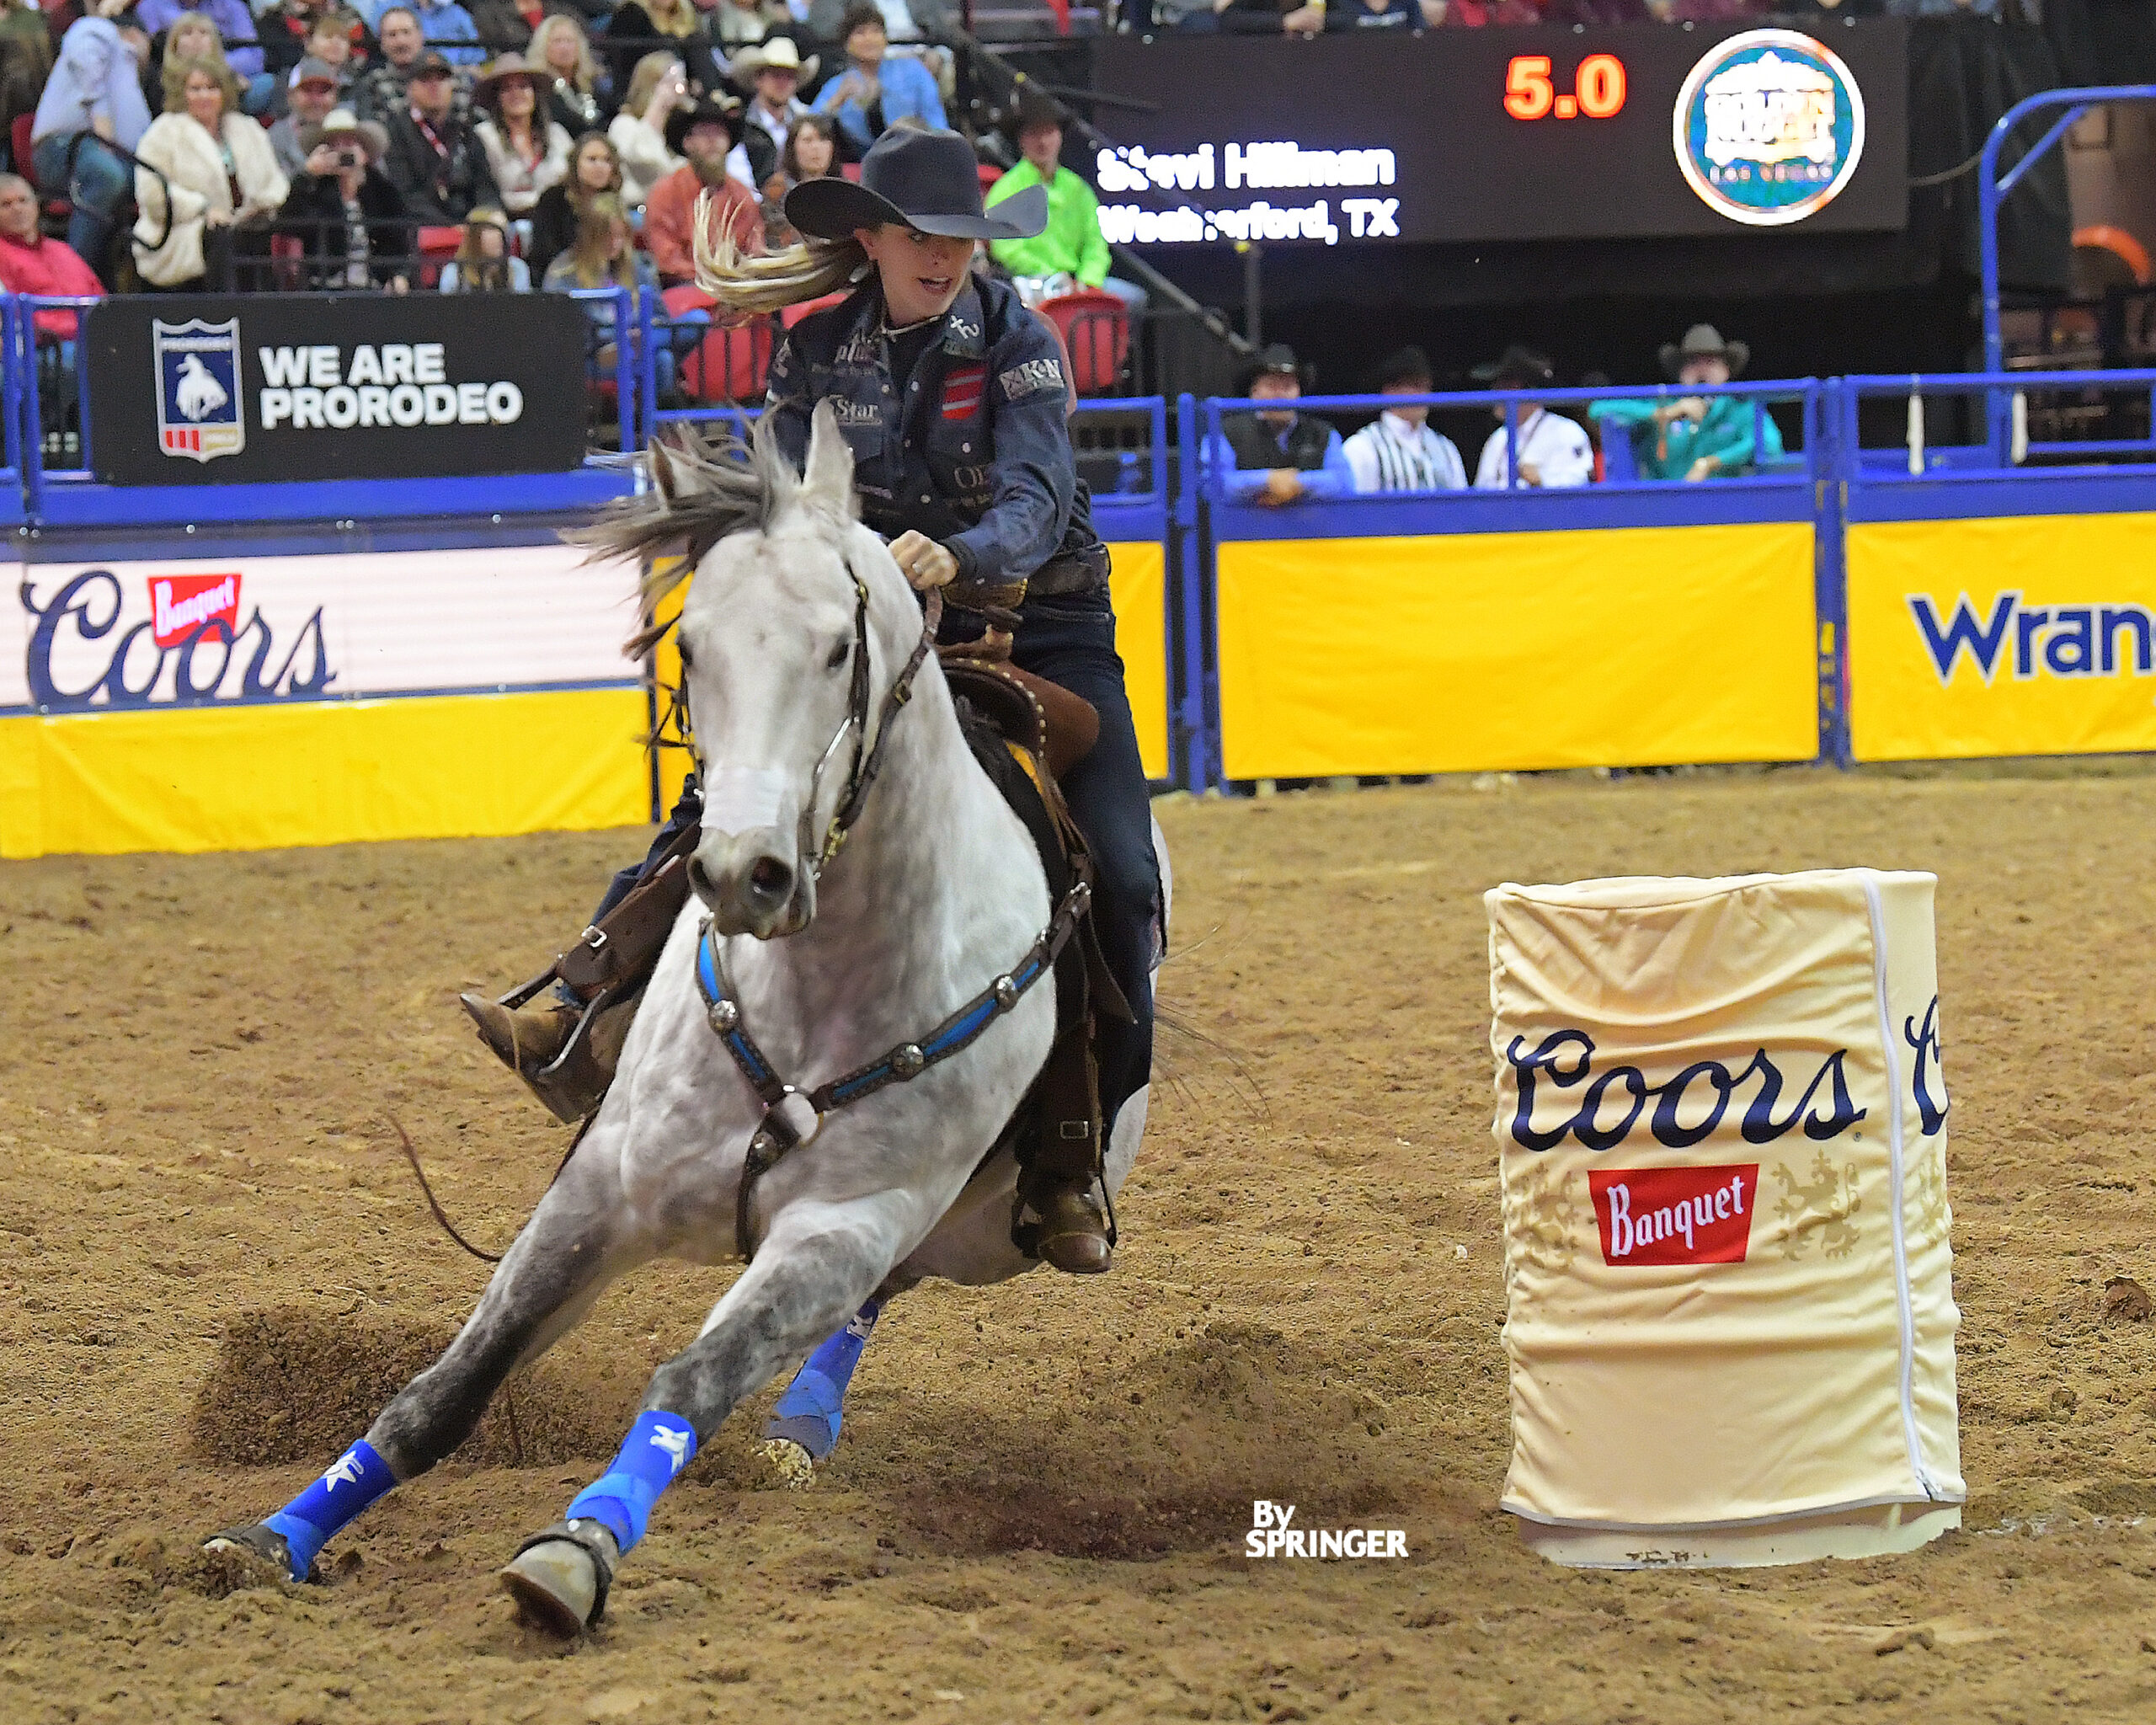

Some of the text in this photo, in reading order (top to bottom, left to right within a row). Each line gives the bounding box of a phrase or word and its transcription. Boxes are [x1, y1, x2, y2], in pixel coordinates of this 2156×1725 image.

[1503, 54, 1627, 120] 5.0
[1341, 198, 1400, 237] TX
[259, 342, 446, 387] WE ARE
[260, 380, 524, 430] PRORODEO
[20, 570, 337, 702] Coors
[154, 575, 235, 638] Banquet
[1907, 591, 2156, 684] Wran
[1507, 1028, 1867, 1151] Coors
[1606, 1175, 1745, 1258] Banquet
